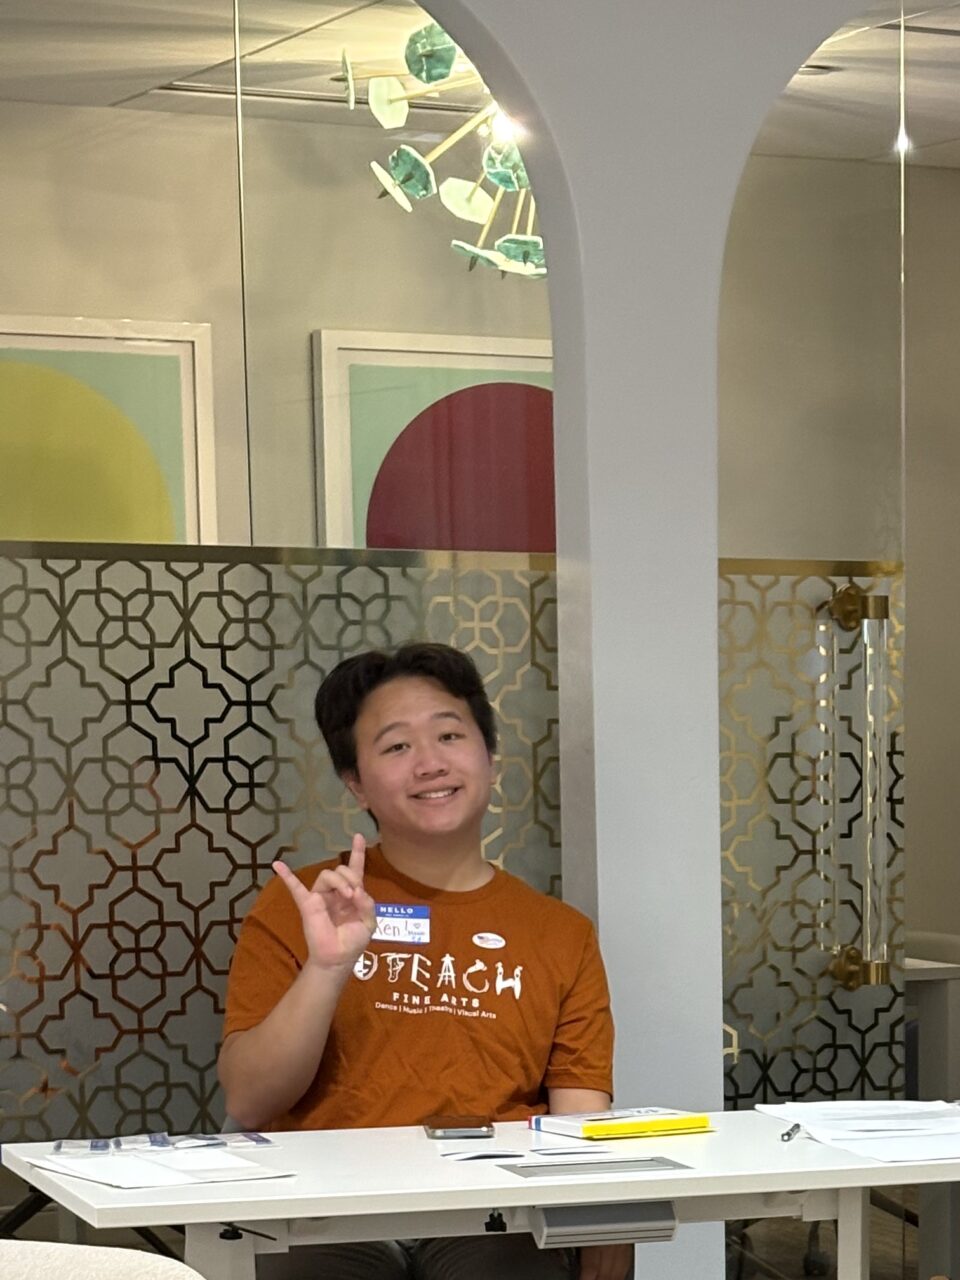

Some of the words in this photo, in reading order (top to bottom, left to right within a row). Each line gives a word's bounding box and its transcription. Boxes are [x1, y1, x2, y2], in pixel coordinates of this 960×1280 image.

[379, 906, 414, 915] HELLO
[392, 992, 431, 1005] FINE
[440, 993, 480, 1007] ARTS
[375, 1001, 398, 1011] Dance
[457, 1009, 480, 1017] Visual
[480, 1010, 497, 1020] Arts
